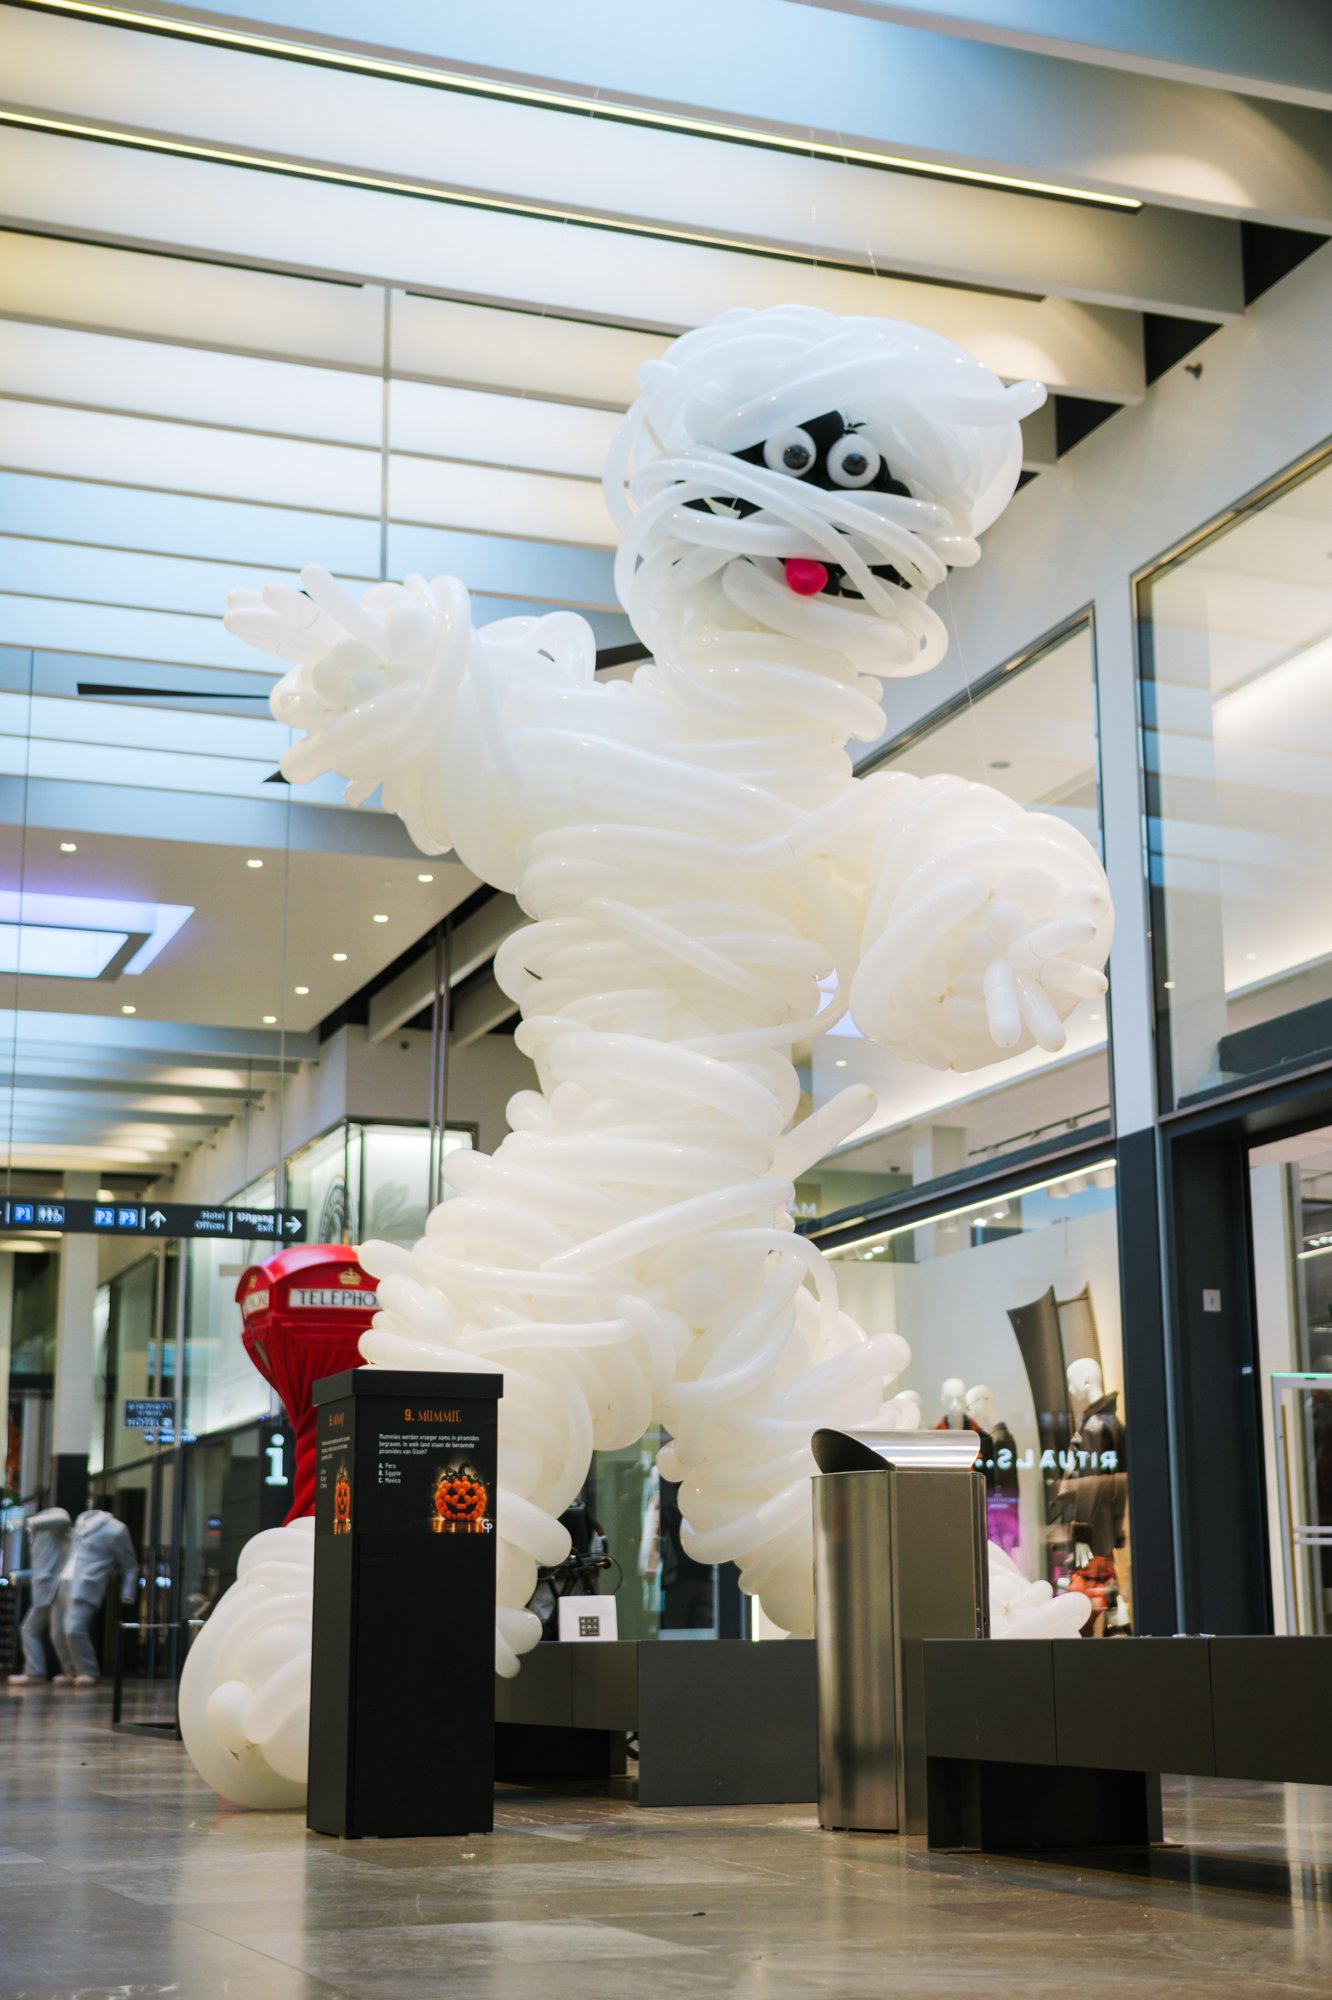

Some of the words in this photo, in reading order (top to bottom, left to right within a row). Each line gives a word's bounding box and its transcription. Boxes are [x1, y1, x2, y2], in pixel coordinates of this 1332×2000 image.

[14, 1206, 32, 1221] P1
[94, 1209, 113, 1225] P2
[118, 1210, 137, 1226] P3
[201, 1210, 226, 1220] Hotel
[236, 1211, 275, 1225] Uitgang
[194, 1220, 226, 1230] Offices
[255, 1223, 274, 1232] Exit
[299, 1290, 380, 1307] TELEPHO
[404, 1408, 415, 1421] 9.
[417, 1409, 462, 1422] MUMMIE
[456, 1434, 480, 1442] piramides
